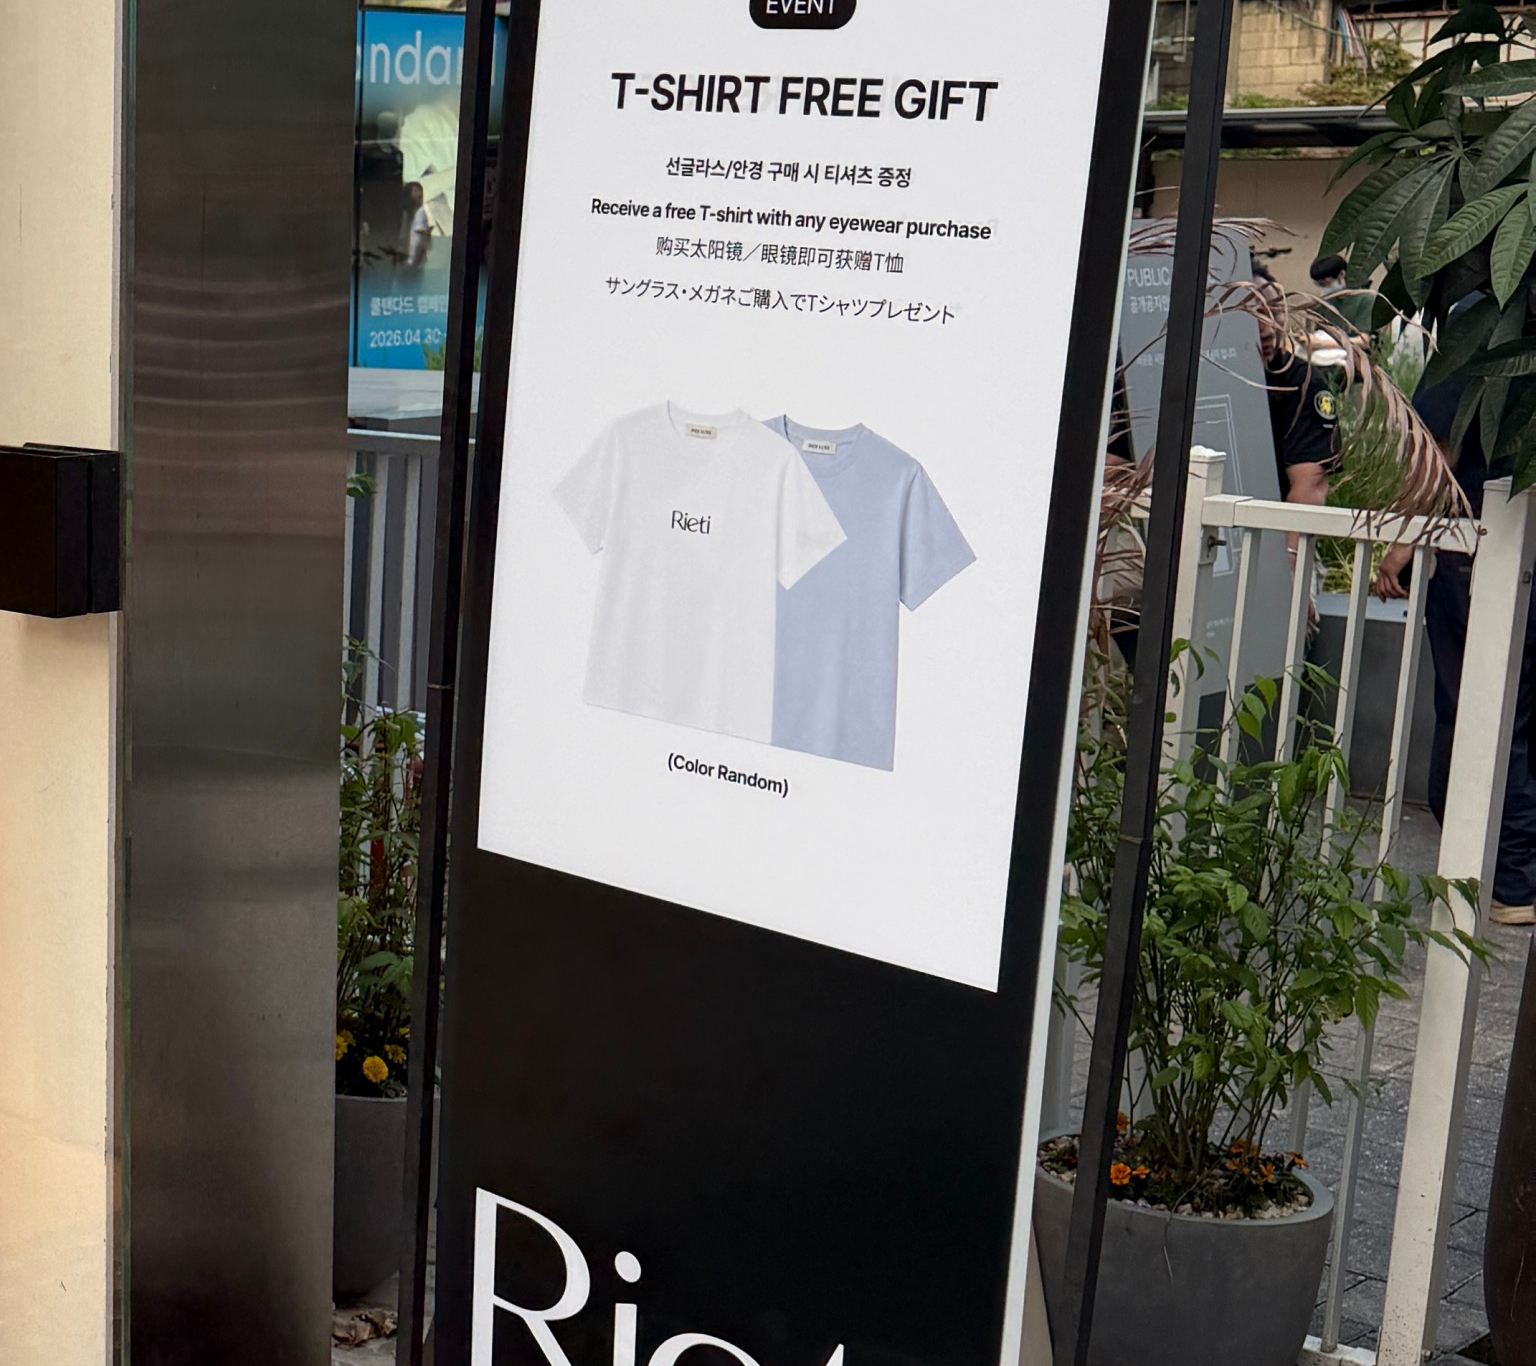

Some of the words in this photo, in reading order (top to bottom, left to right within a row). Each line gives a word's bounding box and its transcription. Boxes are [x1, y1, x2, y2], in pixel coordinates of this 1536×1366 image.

[612, 73, 770, 113] T-SHIRT
[779, 77, 883, 117] FREE
[895, 79, 998, 121] GIFT
[666, 157, 763, 180] 선글라스/안경
[768, 163, 799, 182] 구매
[804, 163, 819, 183] 시
[825, 165, 872, 185] 티셔츠
[878, 168, 911, 188] 증정
[592, 199, 649, 217] Receive
[653, 206, 661, 217] a
[666, 203, 696, 220] free
[700, 205, 753, 223] T-shirt
[757, 209, 791, 226] with
[795, 215, 826, 232] any
[830, 217, 903, 234] eyewear
[906, 220, 991, 239] purchase
[672, 511, 710, 534] Rieti
[668, 753, 714, 776] (Color
[718, 765, 788, 798] Random)
